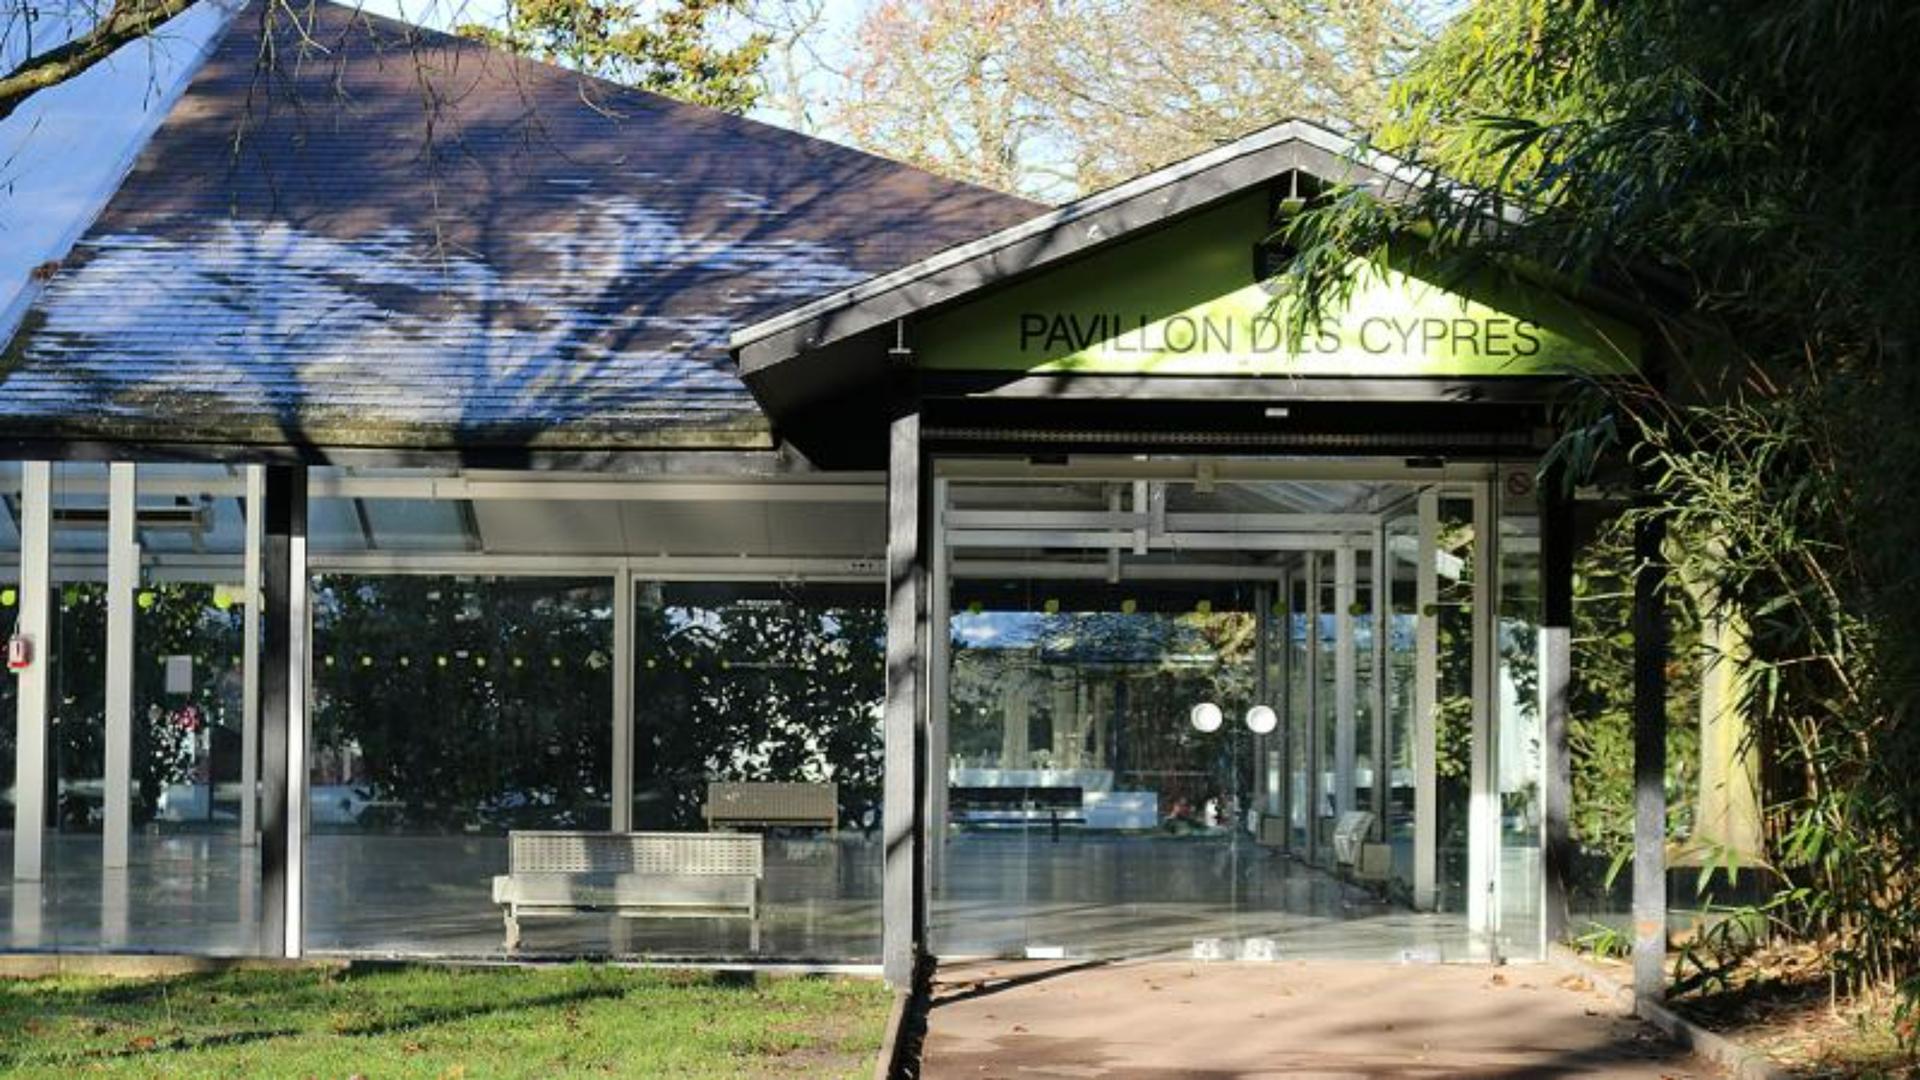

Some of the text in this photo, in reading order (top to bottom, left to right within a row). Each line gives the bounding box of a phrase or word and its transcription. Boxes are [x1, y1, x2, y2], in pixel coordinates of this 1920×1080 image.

[1019, 314, 1540, 356] PAVILLON DES CYPRES
